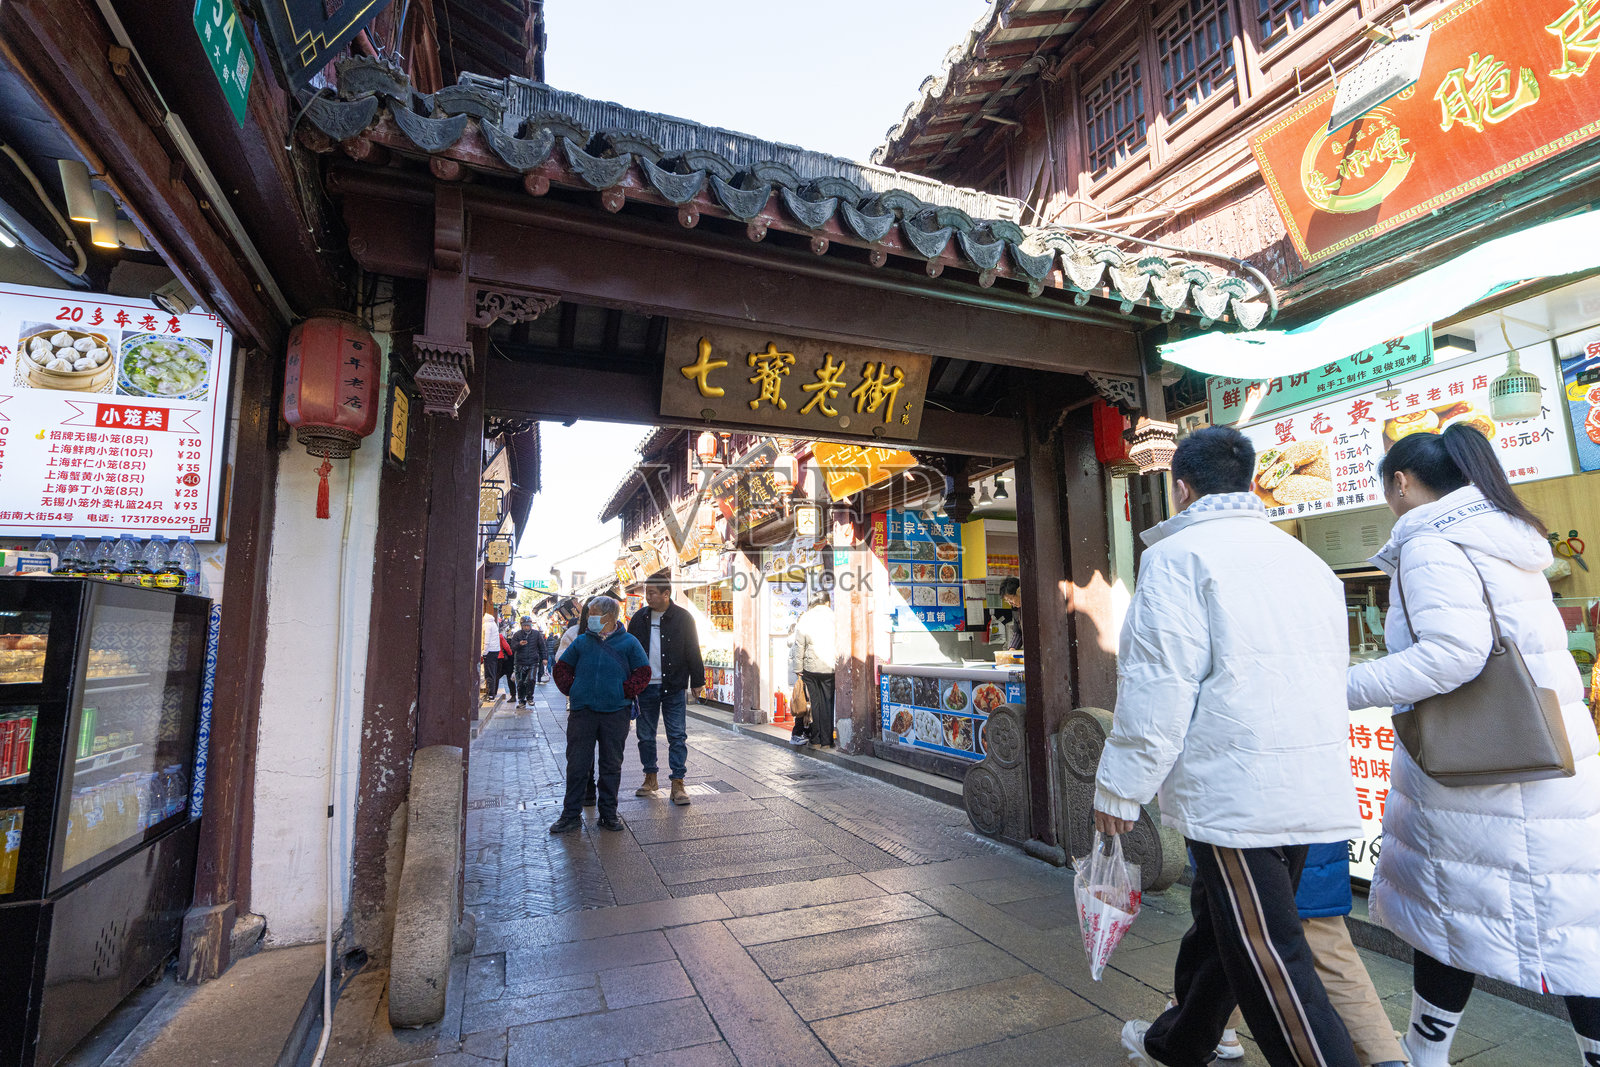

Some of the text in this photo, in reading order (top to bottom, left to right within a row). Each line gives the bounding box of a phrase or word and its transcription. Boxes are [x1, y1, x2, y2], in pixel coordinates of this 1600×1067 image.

[56, 306, 182, 334] 20多年老店
[343, 338, 367, 409] 百年老店
[1317, 354, 1417, 392] 纯手工制作 现做现烤
[1385, 374, 1489, 412] 七宝老街店
[101, 407, 163, 428] 小笼类
[1275, 399, 1377, 446] 蟹壳黄
[1332, 427, 1370, 445] 4元一个
[1500, 427, 1554, 449] 35元8个
[48, 444, 154, 458] 上海鲜肉小笼(10只)
[1334, 444, 1372, 461] 15元4个
[46, 457, 146, 471] 上海虾仁小笼(8只)
[1336, 460, 1374, 477] 28元8个
[44, 470, 145, 484] 上海蟹黄小笼(8只)
[1336, 476, 1377, 492] 32元10个
[43, 483, 144, 497] 上海笋丁小笼(8只)
[41, 497, 163, 511] 无锡小笼外卖礼篮24只
[1433, 516, 1456, 528] FILA
[1467, 503, 1488, 513] NATA
[890, 521, 955, 537] 正宗宁波菜
[1349, 723, 1395, 751] 特色
[1412, 1013, 1456, 1042] S
